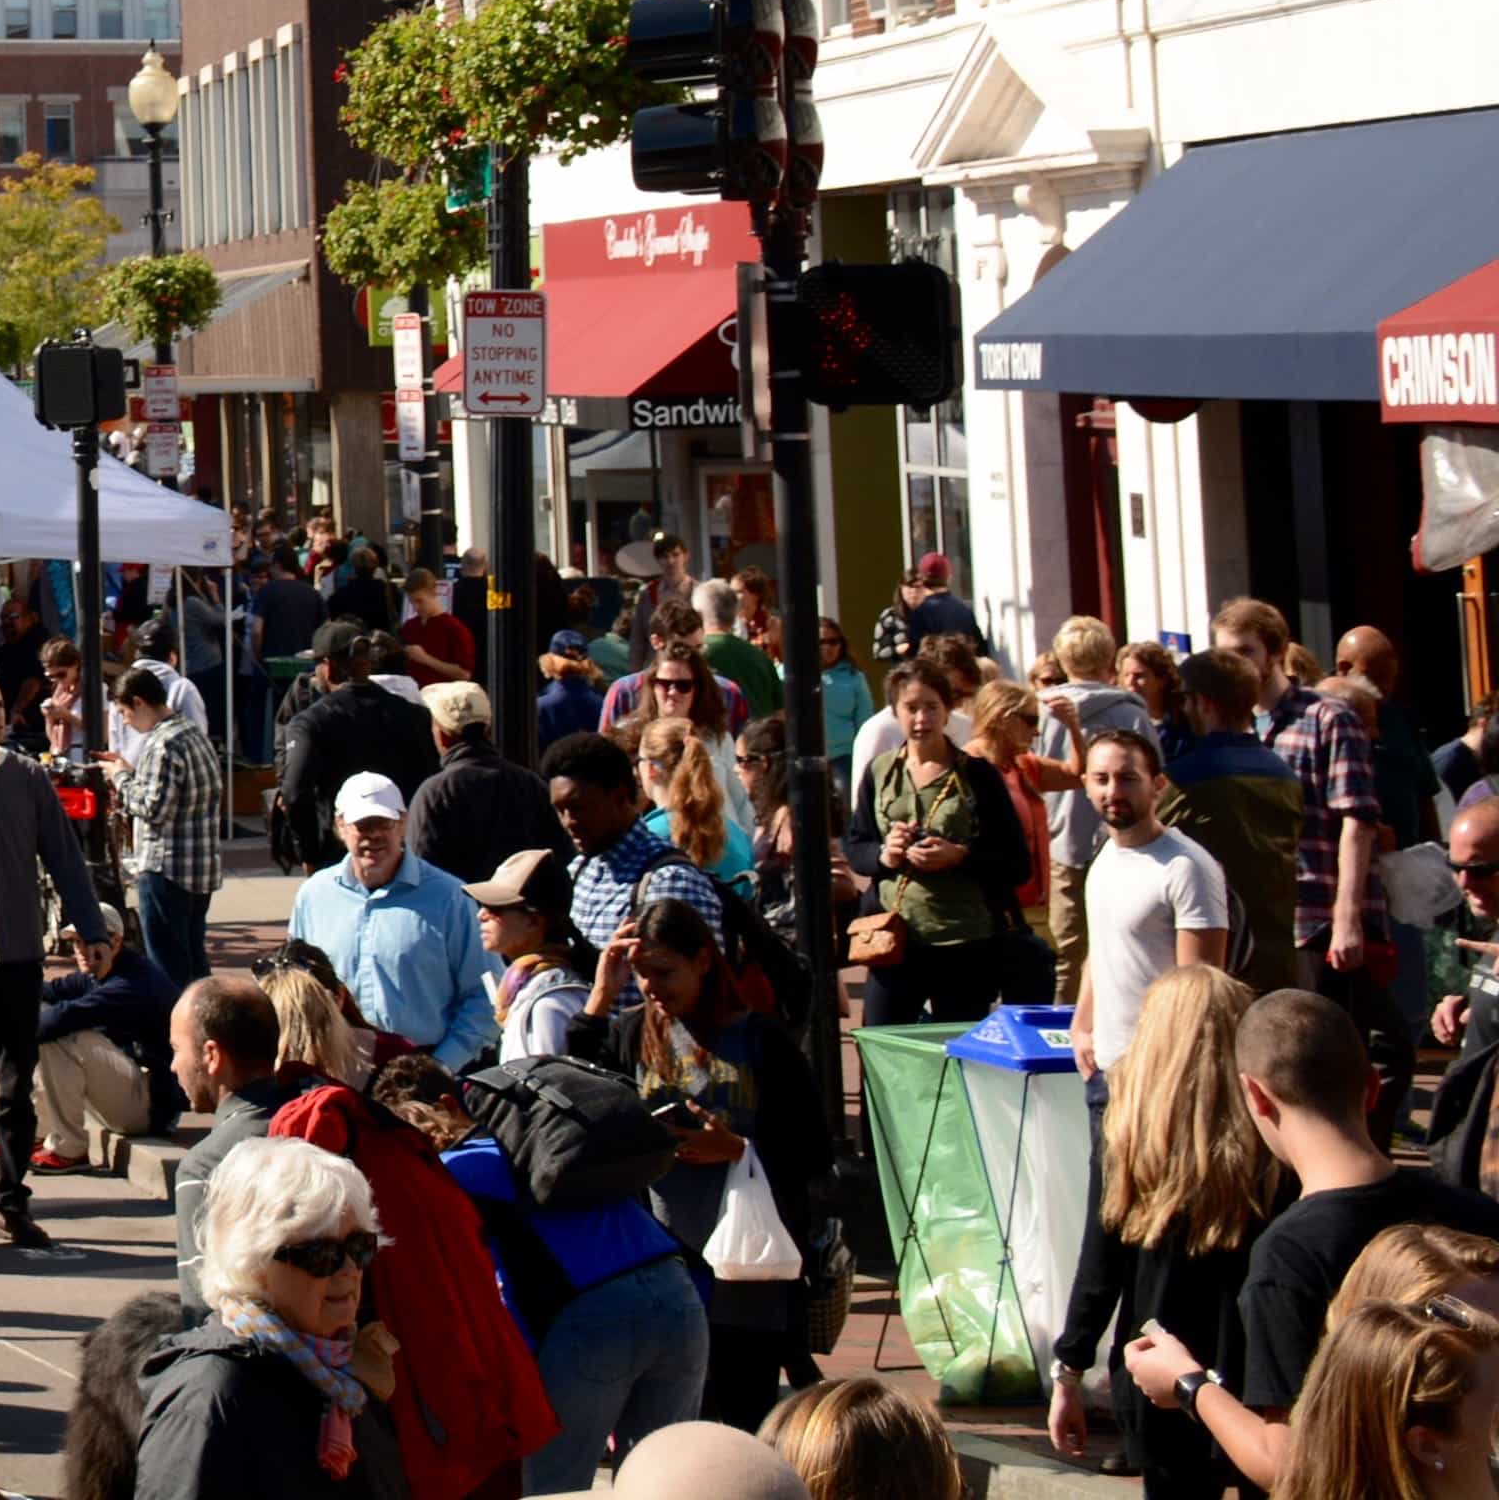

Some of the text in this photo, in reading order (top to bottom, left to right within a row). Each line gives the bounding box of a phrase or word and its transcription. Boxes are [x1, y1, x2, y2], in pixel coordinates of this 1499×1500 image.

[467, 297, 543, 315] TOW ZONE
[491, 323, 515, 338] NO
[471, 346, 538, 361] STOPPING
[978, 342, 1043, 381] TORY ROW
[473, 369, 536, 385] ANYTIME
[1382, 332, 1497, 407] CRIMSON
[633, 397, 743, 428] Sandwic
